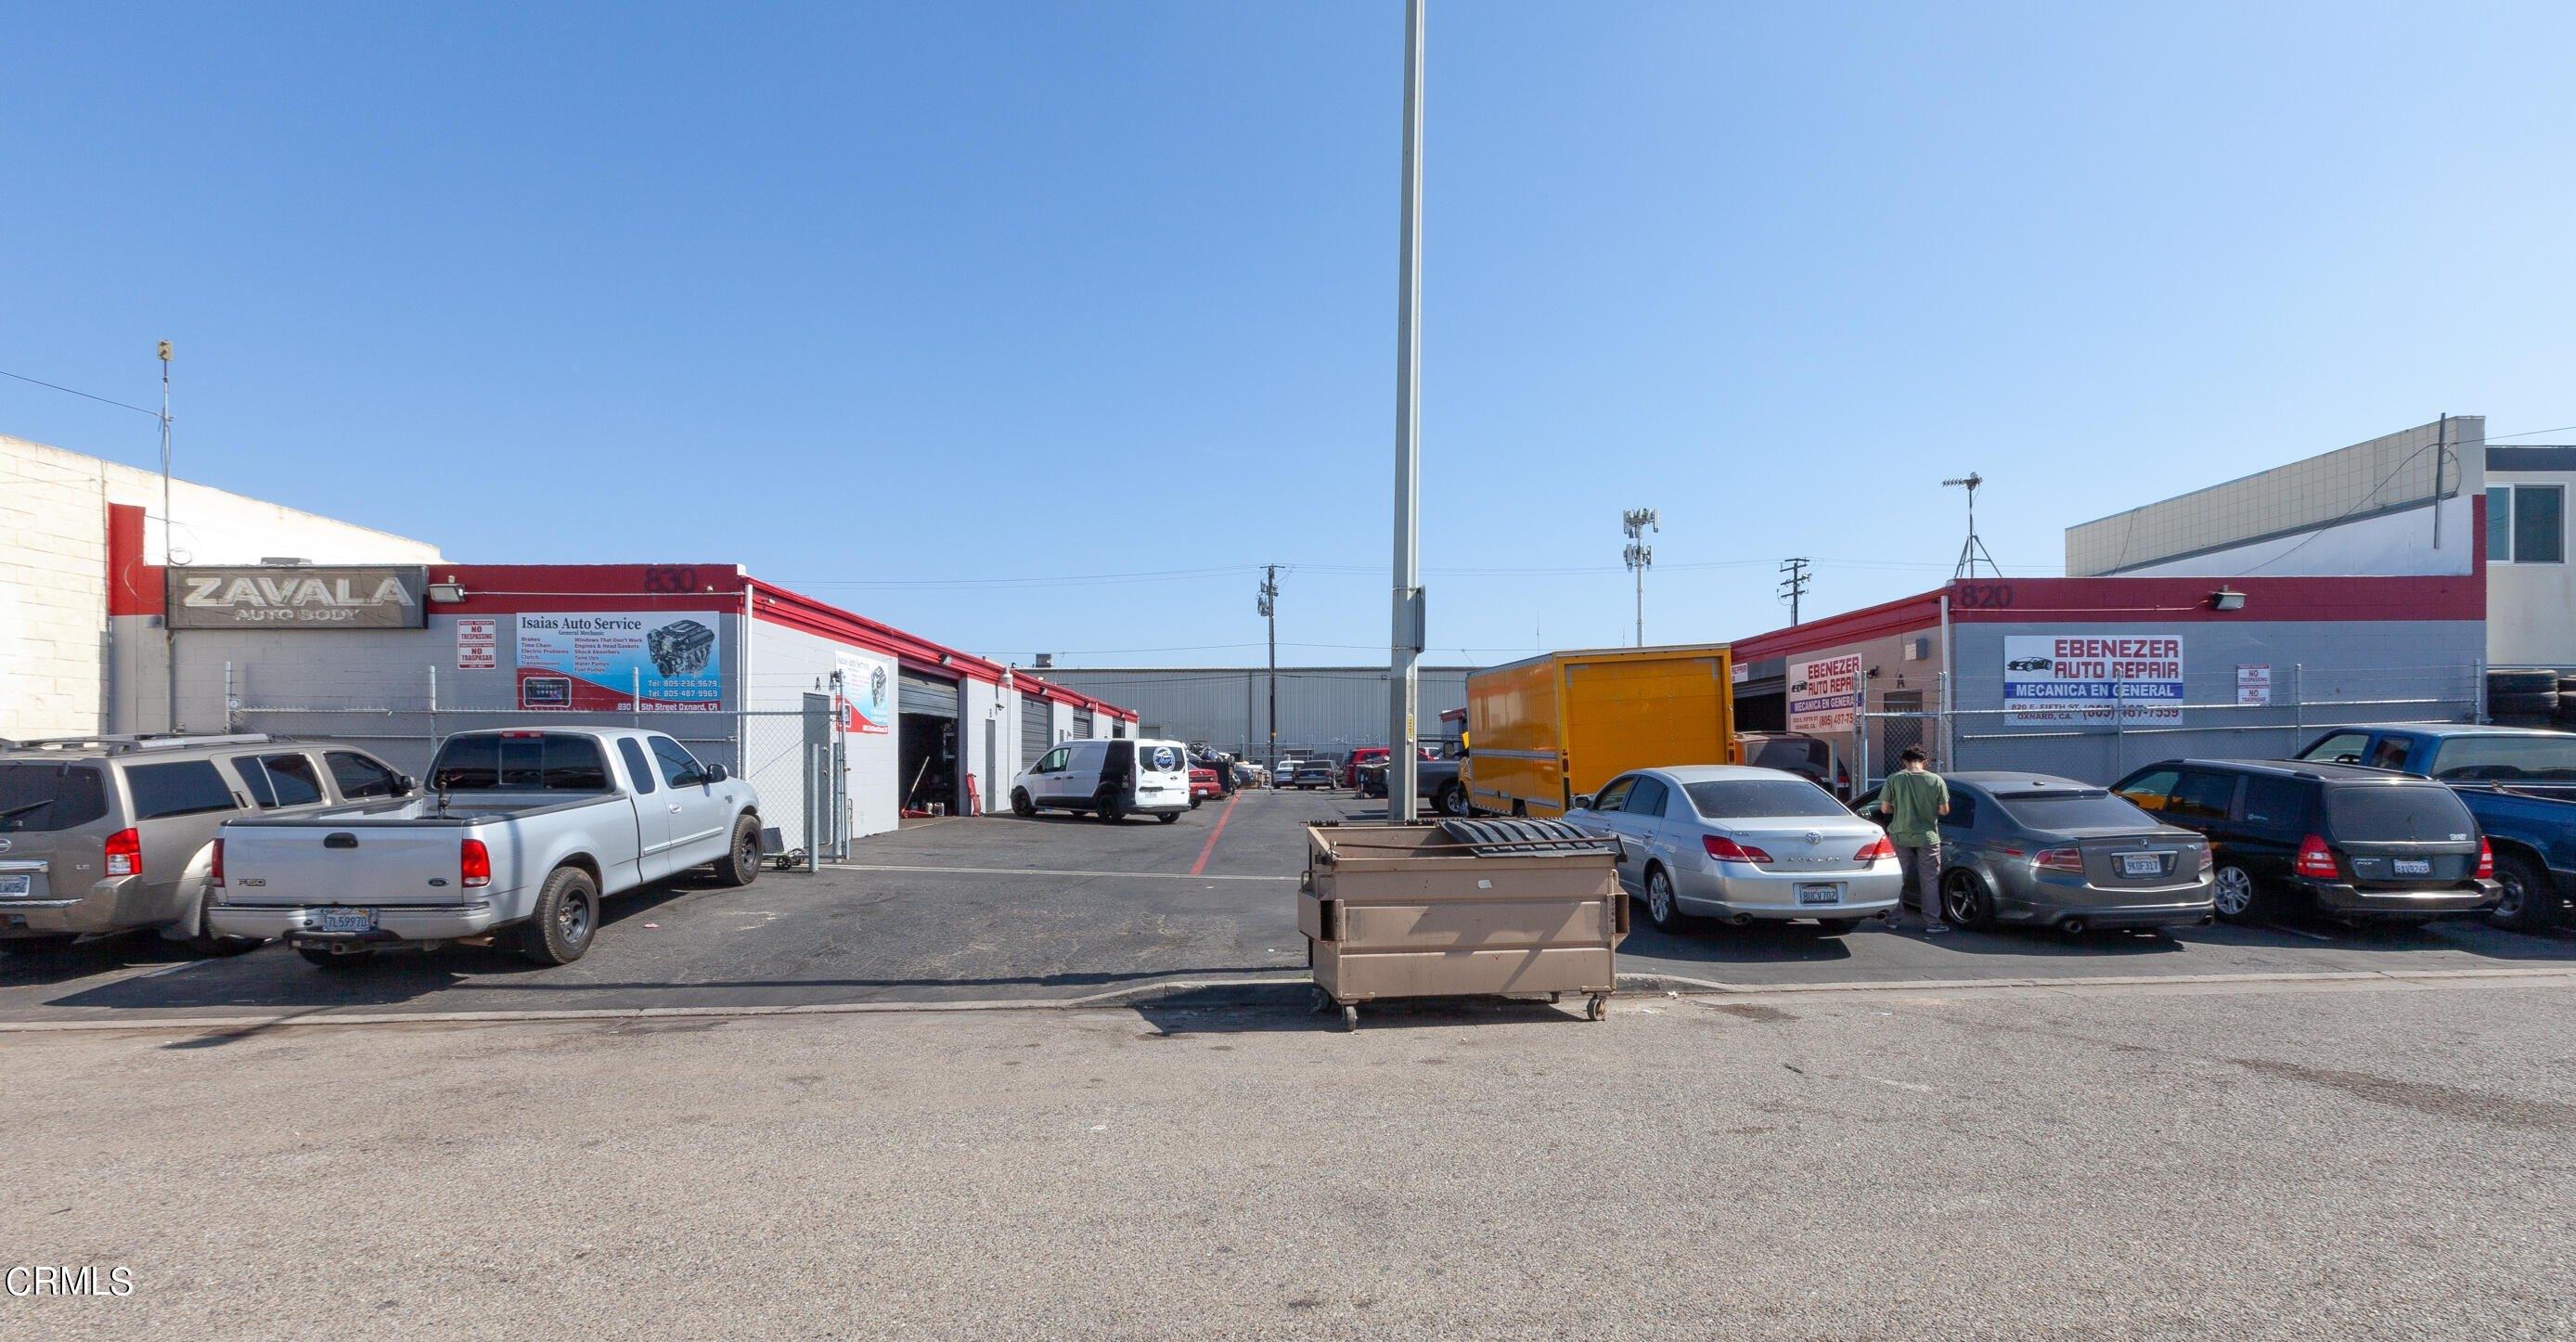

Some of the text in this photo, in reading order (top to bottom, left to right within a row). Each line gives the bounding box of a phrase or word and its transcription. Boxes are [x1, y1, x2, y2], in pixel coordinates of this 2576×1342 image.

[645, 567, 696, 593] 830
[185, 577, 416, 607] ZAVALA
[1961, 585, 2014, 607] 820
[235, 609, 362, 621] AUTO BODY
[522, 616, 642, 630] Isaias Auto Service
[2054, 639, 2179, 658] EBENEZER
[1808, 656, 1860, 679] EBENEZER
[2054, 662, 2179, 678] AUTO REPAIR
[1808, 676, 1855, 696] AUTO REPAI
[2016, 684, 2174, 696] MECANICA EN GENERAL
[1831, 695, 1855, 707] GENERA
[1834, 713, 1854, 725] 487-75
